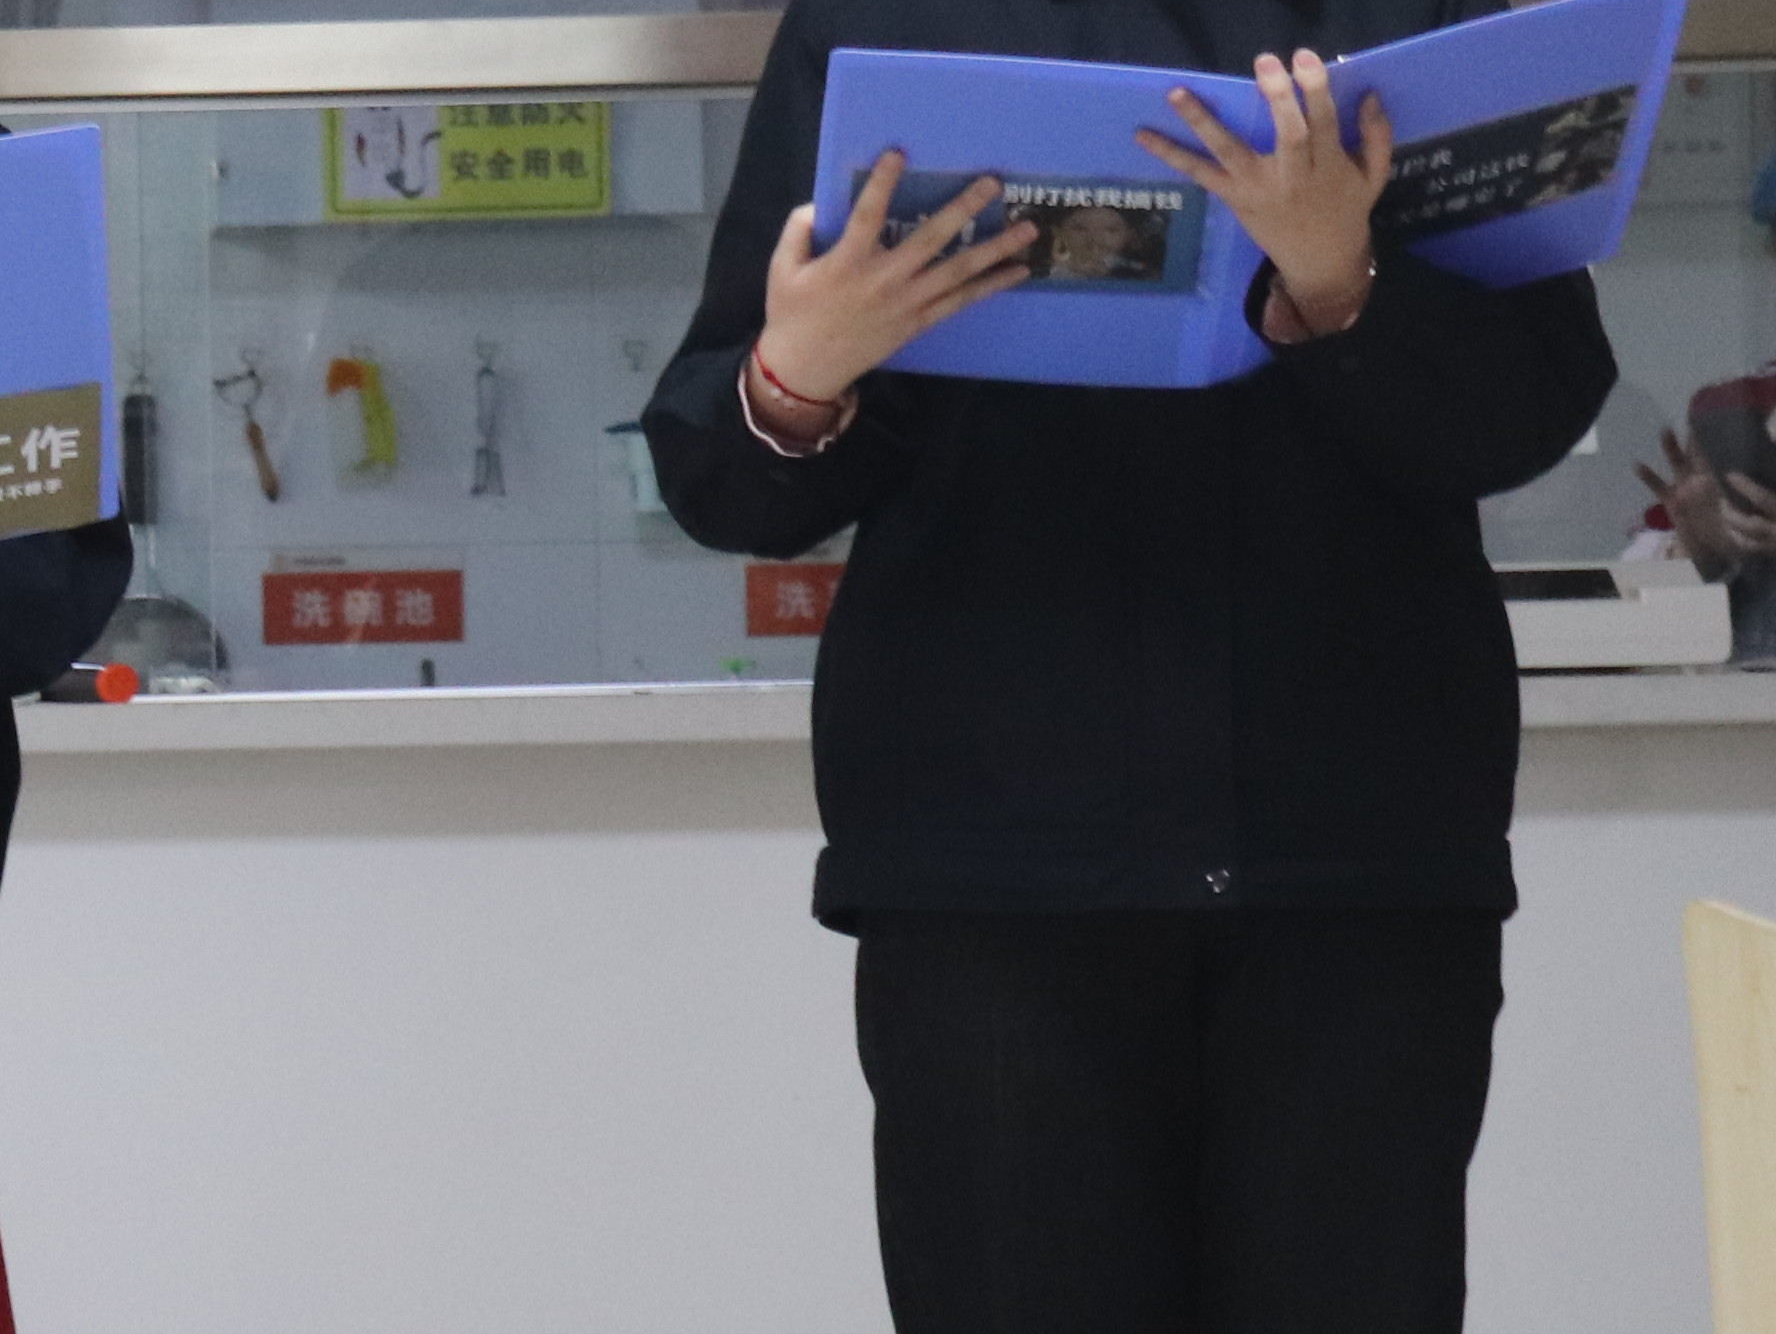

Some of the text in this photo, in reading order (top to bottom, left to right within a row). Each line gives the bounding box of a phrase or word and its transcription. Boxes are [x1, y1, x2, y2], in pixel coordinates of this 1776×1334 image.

[451, 148, 587, 180] 安全用电
[293, 587, 434, 627] 洗碗池
[775, 580, 839, 620] 洗
